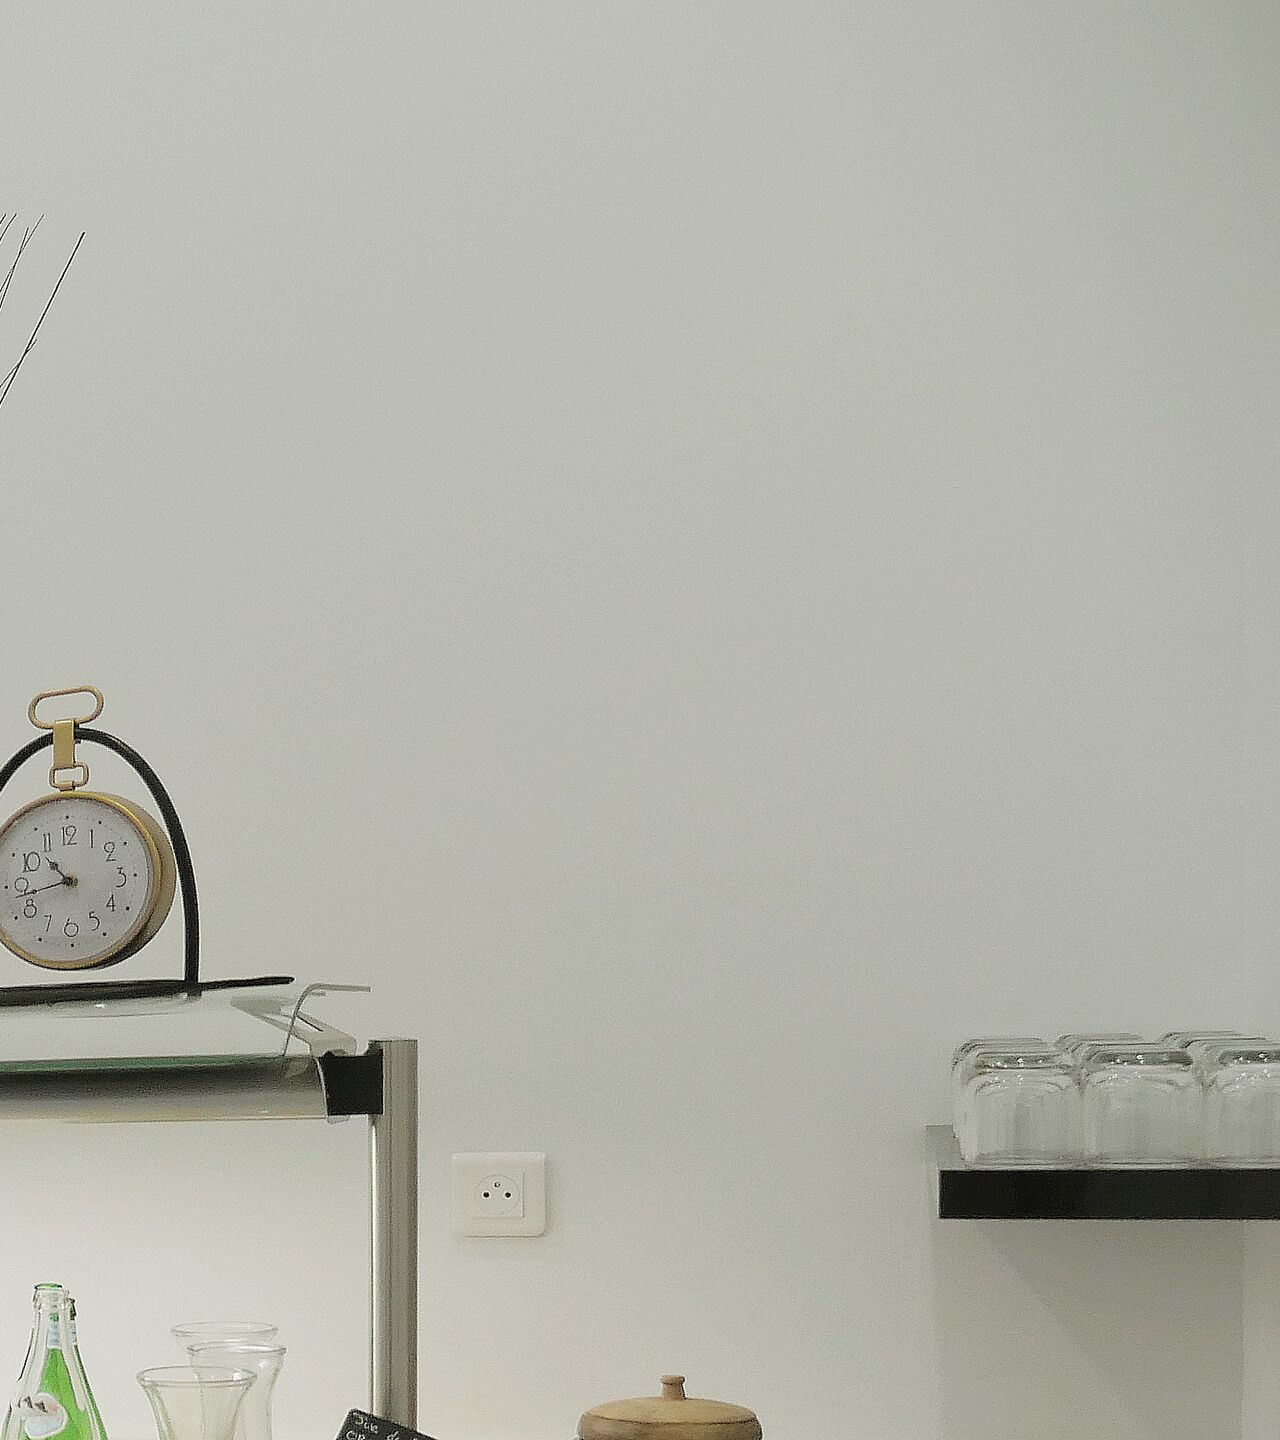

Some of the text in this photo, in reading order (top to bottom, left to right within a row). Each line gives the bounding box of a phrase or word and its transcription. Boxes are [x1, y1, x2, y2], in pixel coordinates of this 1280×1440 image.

[42, 832, 52, 852] 11
[61, 825, 77, 846] 12
[22, 850, 41, 873] 10
[103, 841, 117, 862] 2
[14, 876, 29, 896] 9
[115, 867, 127, 888] 3
[23, 898, 37, 919] 8
[105, 893, 116, 913] 4
[43, 914, 53, 932] 7
[63, 917, 79, 938] 6
[89, 911, 101, 932] 5
